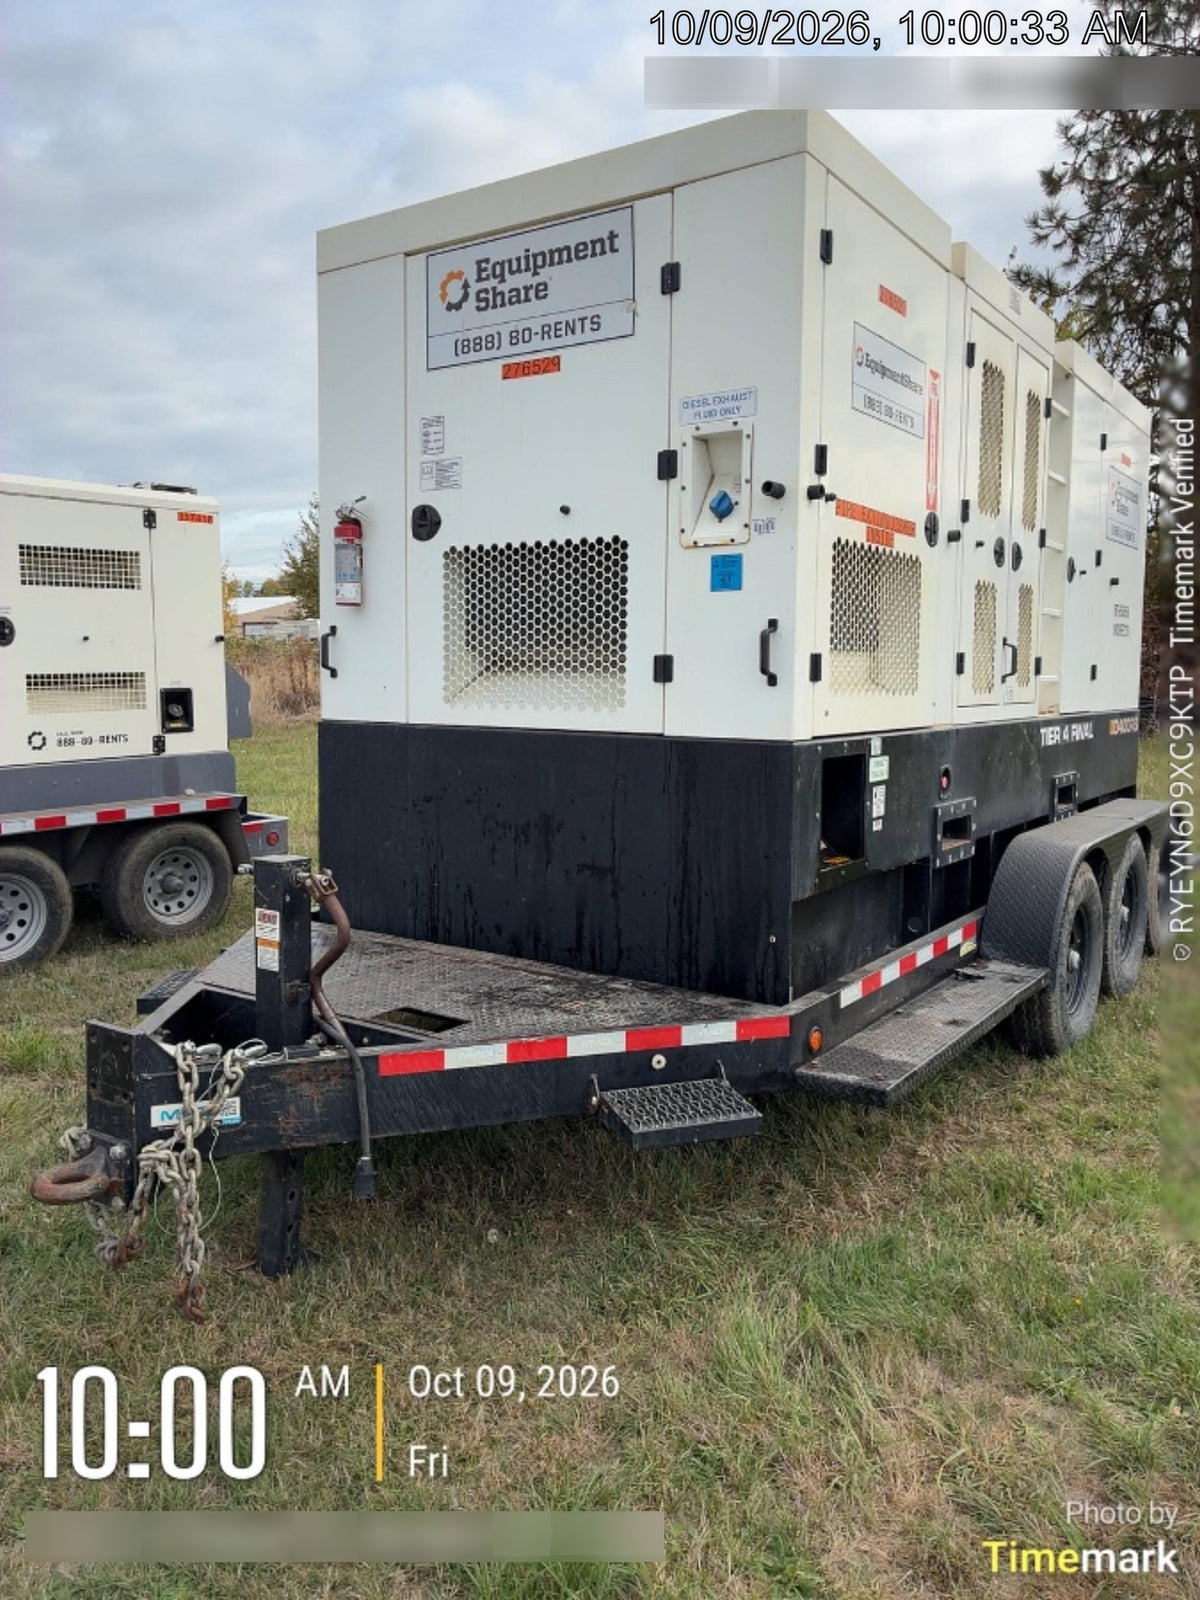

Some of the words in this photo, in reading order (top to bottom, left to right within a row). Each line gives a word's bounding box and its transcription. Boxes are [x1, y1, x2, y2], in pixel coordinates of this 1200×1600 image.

[475, 230, 620, 284] Equipment
[475, 281, 549, 312] Share
[454, 332, 502, 357] (888)
[509, 314, 602, 346] 80-RENTS
[502, 356, 561, 380] 276529
[682, 397, 711, 410] DIESEL
[713, 390, 753, 406] EXHAUST
[719, 405, 742, 417] ONLY
